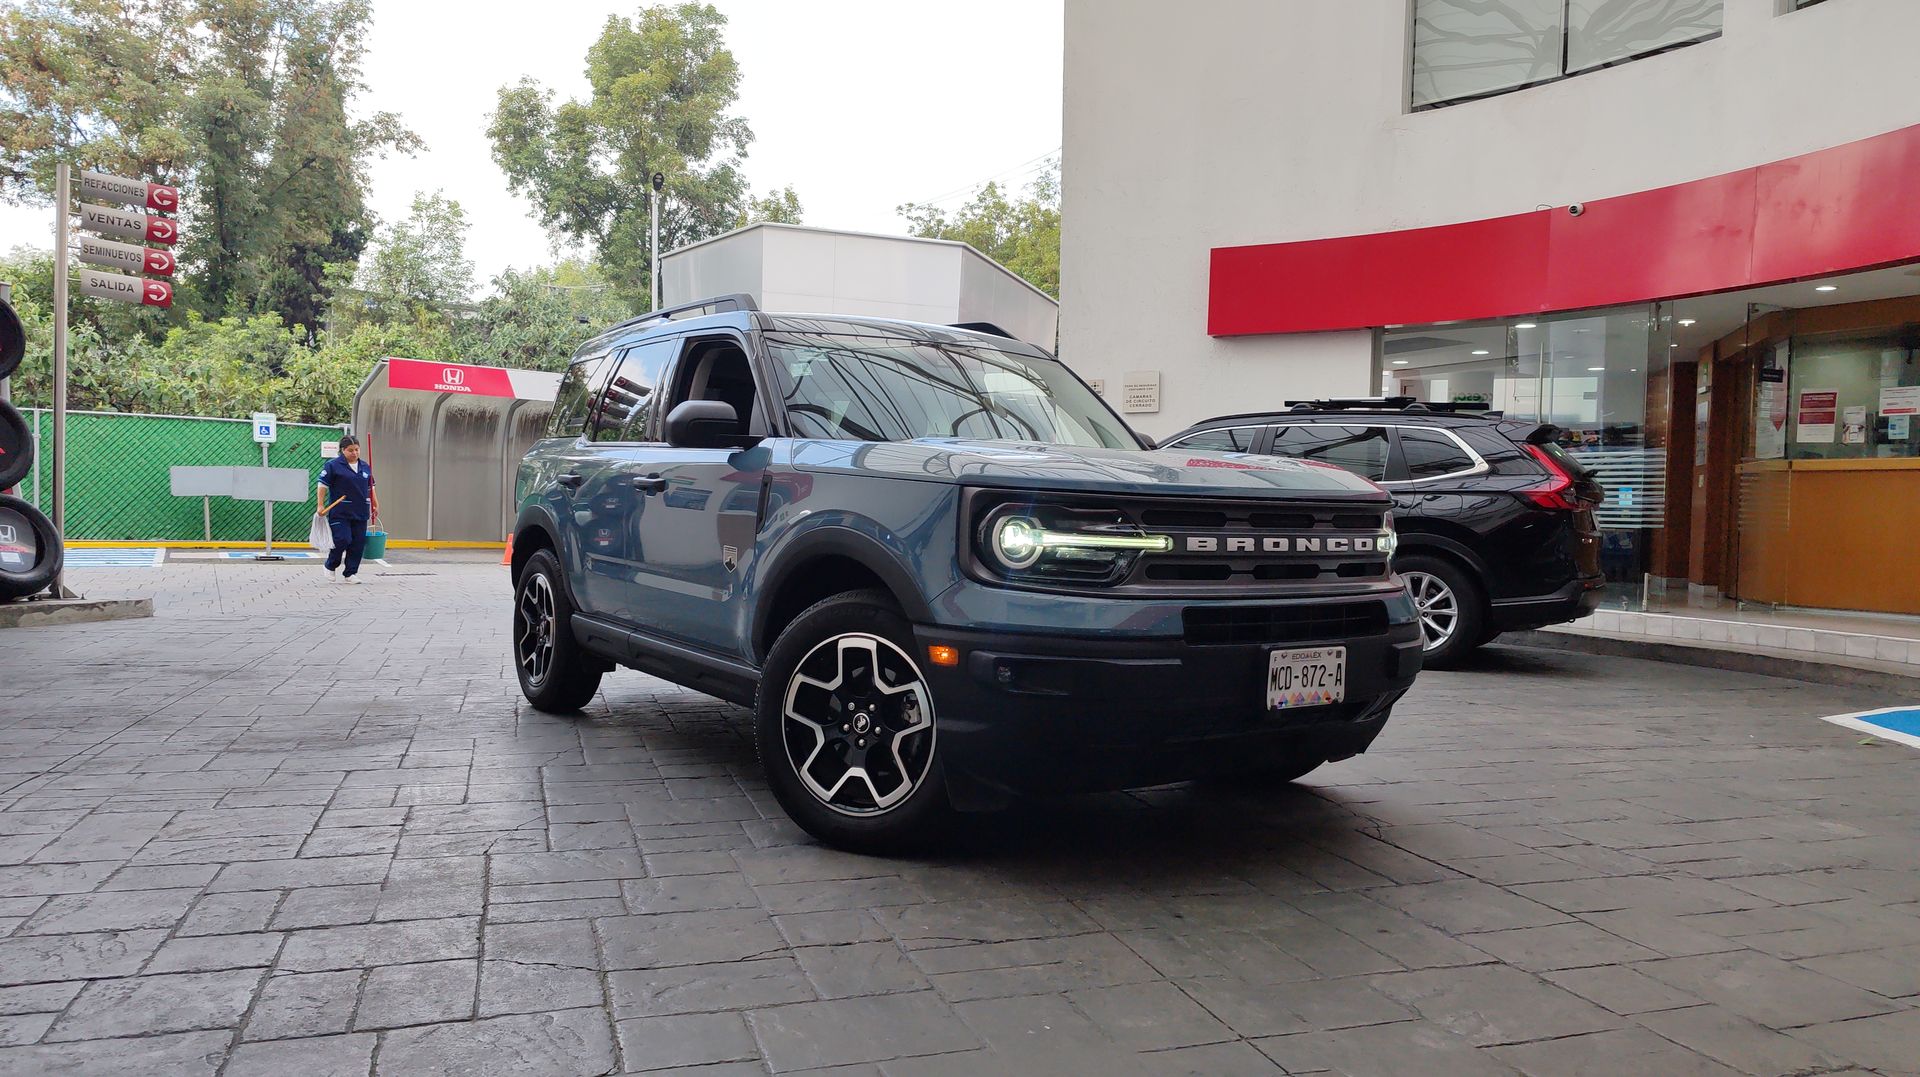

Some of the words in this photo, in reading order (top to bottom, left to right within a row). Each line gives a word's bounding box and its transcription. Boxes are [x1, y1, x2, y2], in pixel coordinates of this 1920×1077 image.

[84, 178, 145, 197] REFACCIONES
[88, 212, 142, 230] VENTAS
[83, 244, 142, 262] SEMINUEVOS
[90, 278, 135, 293] SALIDA
[434, 384, 471, 392] HONDA
[1186, 537, 1374, 552] BRONCO
[1270, 663, 1342, 691] MCD-872-A
